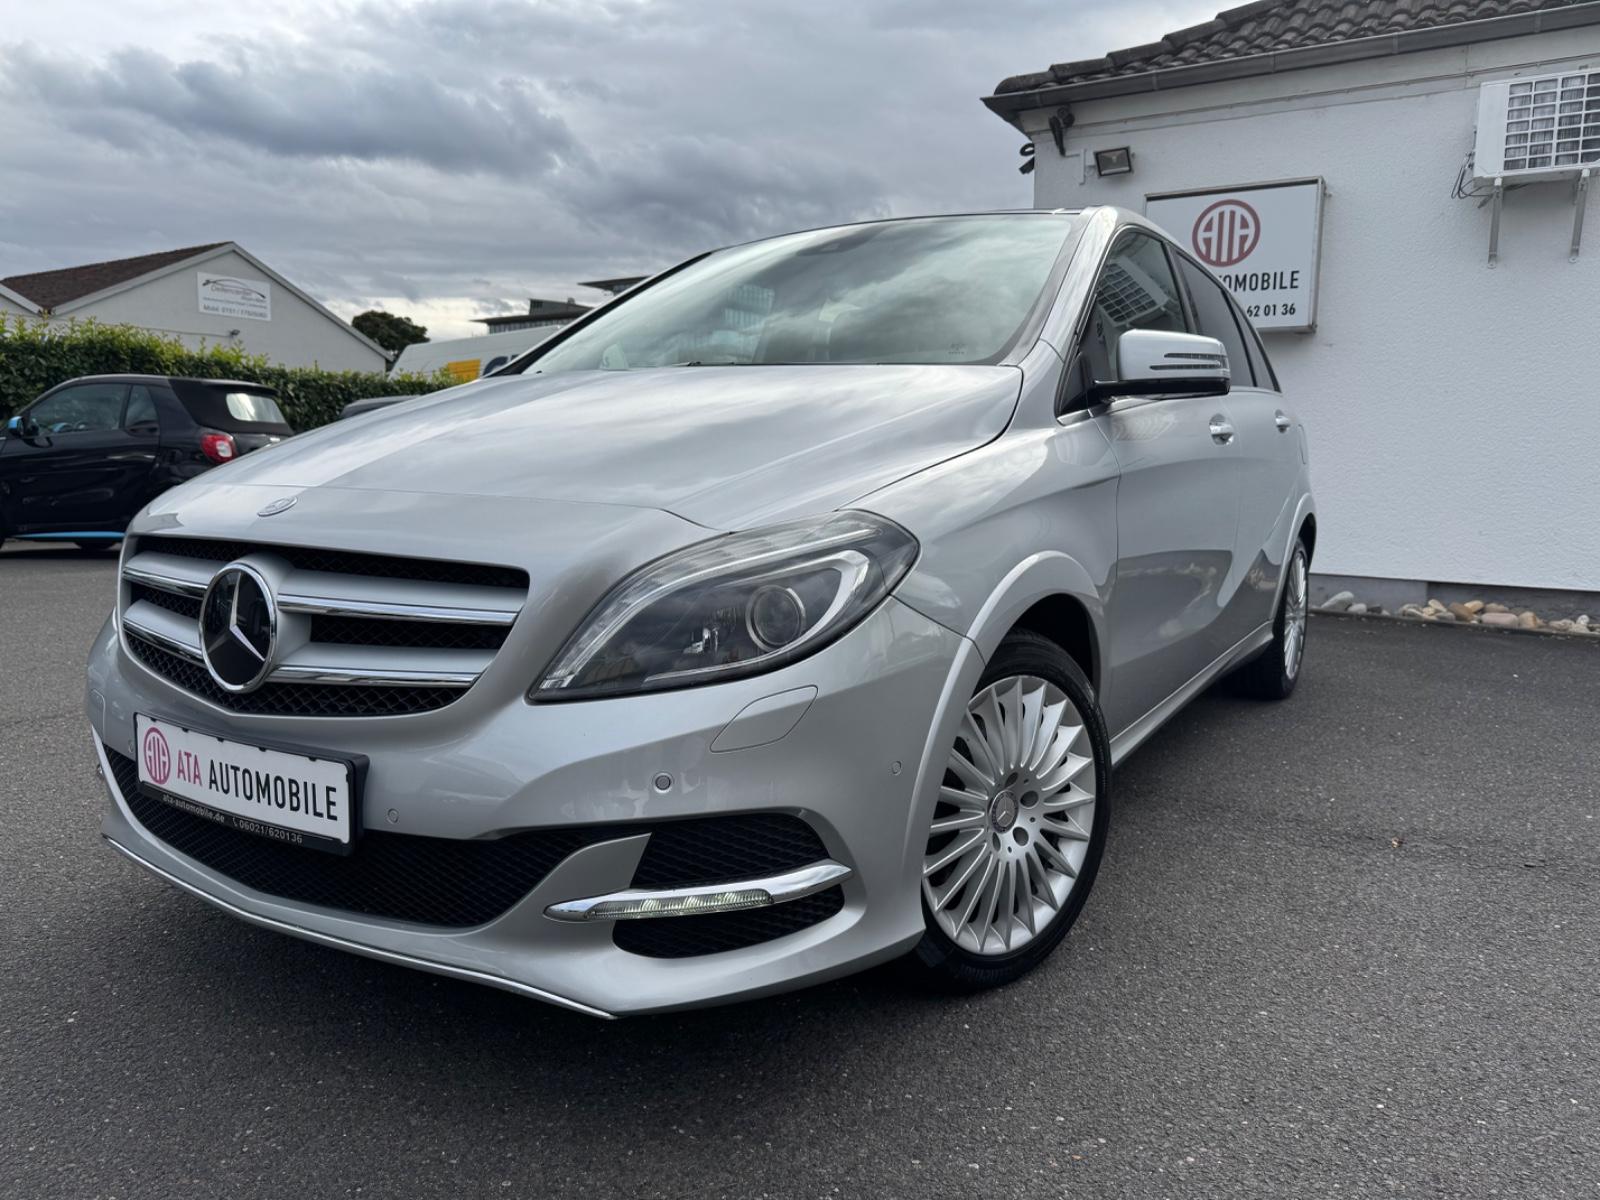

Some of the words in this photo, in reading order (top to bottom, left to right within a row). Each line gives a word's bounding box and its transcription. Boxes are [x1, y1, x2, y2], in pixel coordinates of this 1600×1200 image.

[1219, 270, 1299, 293] OMOBILE
[1264, 304, 1277, 317] 01
[1281, 303, 1296, 316] 36
[177, 749, 202, 787] ATA
[208, 759, 338, 822] AUTOMOBILE
